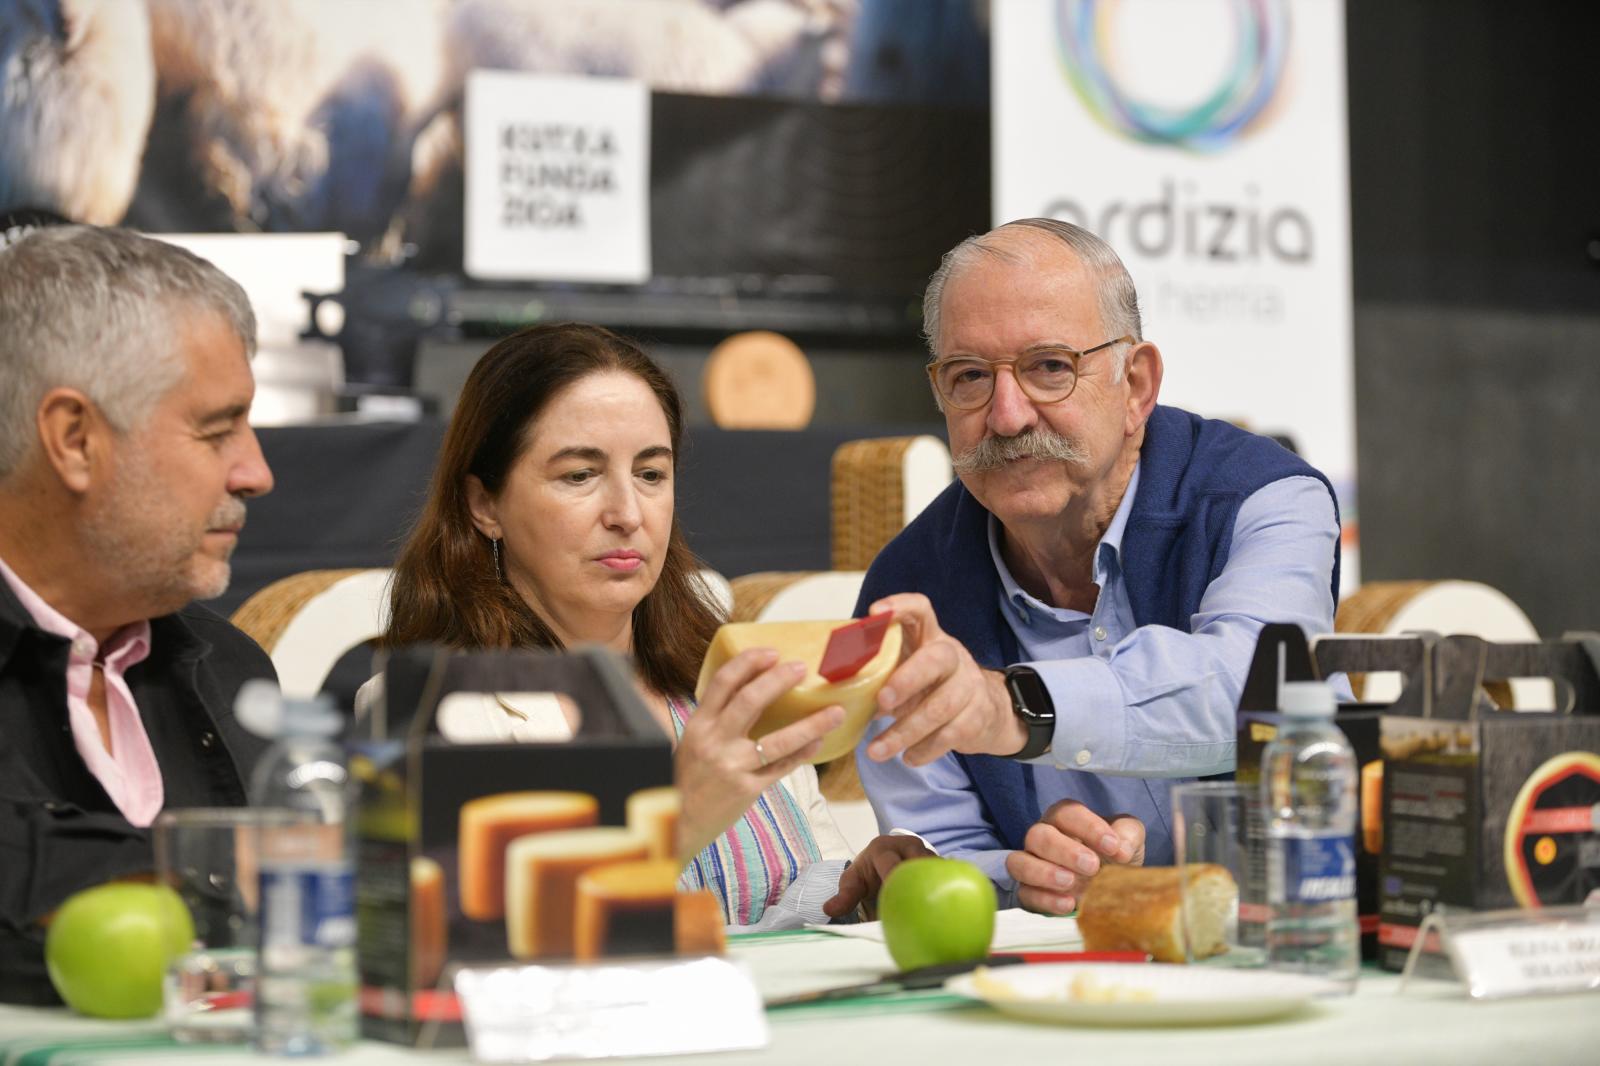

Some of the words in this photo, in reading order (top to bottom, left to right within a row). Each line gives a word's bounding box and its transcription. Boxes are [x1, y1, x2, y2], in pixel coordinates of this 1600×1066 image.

[500, 123, 618, 155] KUTXA
[500, 162, 618, 192] FUNDA
[500, 199, 583, 229] ZIOA
